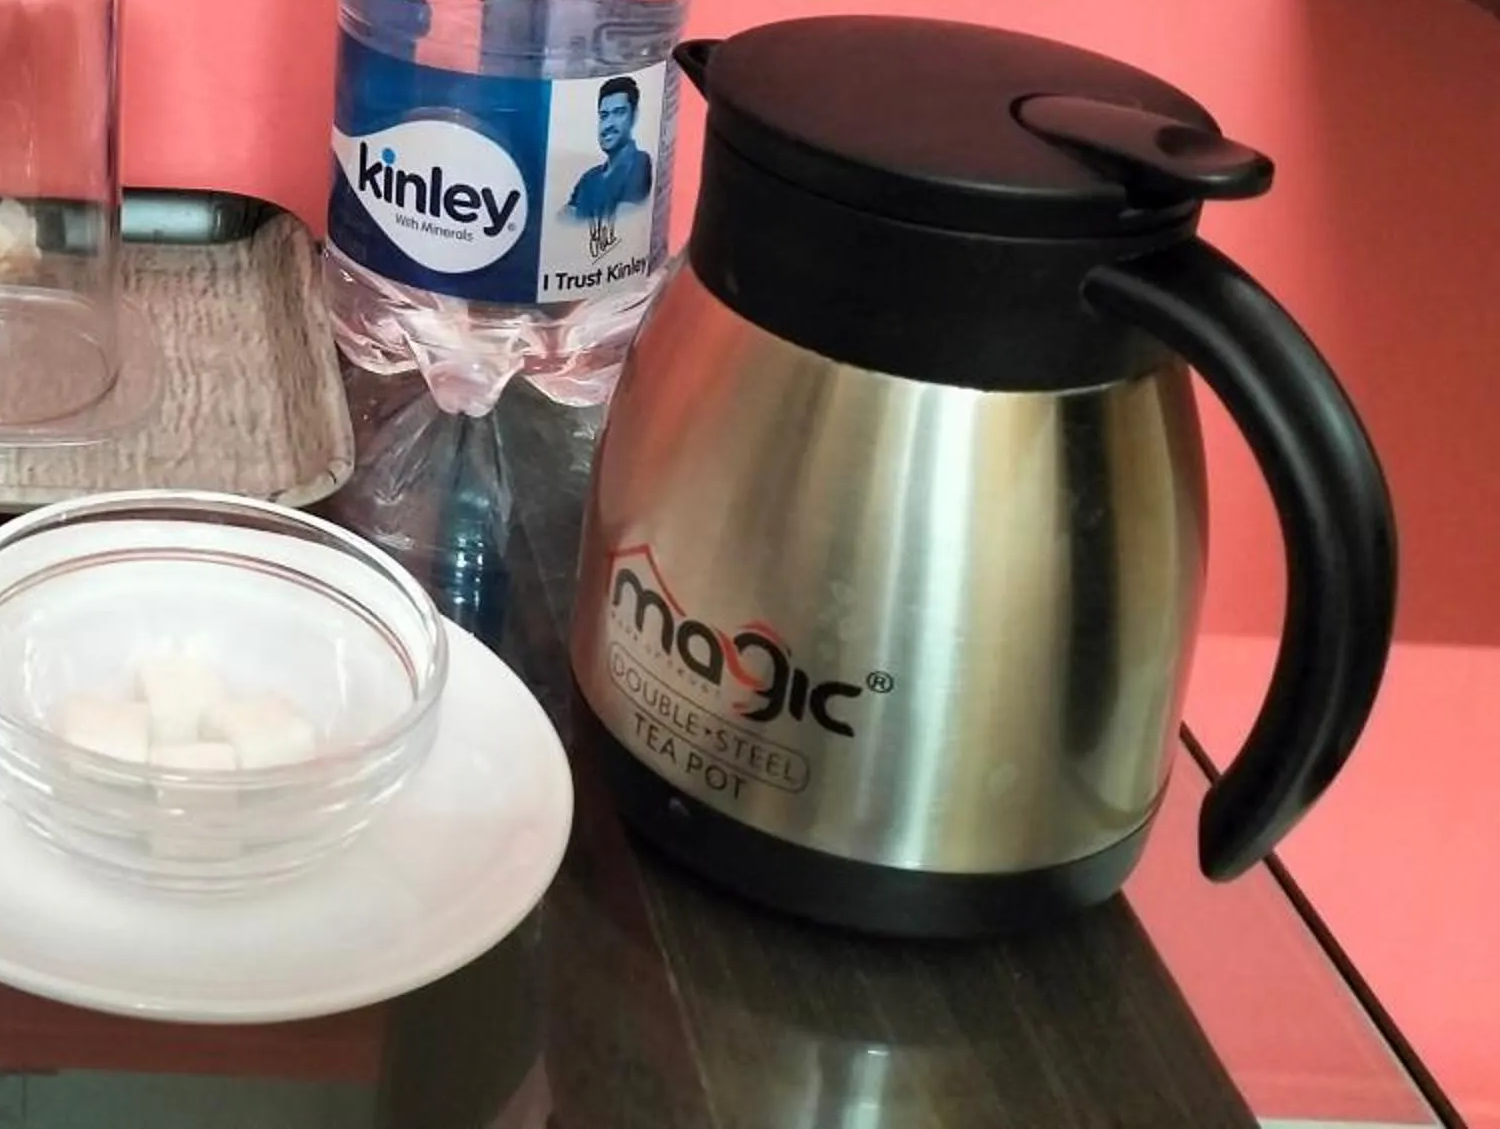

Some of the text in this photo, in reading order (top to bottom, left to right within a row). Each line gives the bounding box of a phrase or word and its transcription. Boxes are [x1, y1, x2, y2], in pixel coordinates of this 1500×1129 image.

[358, 141, 521, 237] kinley
[395, 212, 475, 242] With Minerals
[543, 274, 549, 291] I
[555, 268, 603, 291] Trust
[634, 711, 748, 800] TEA POT
